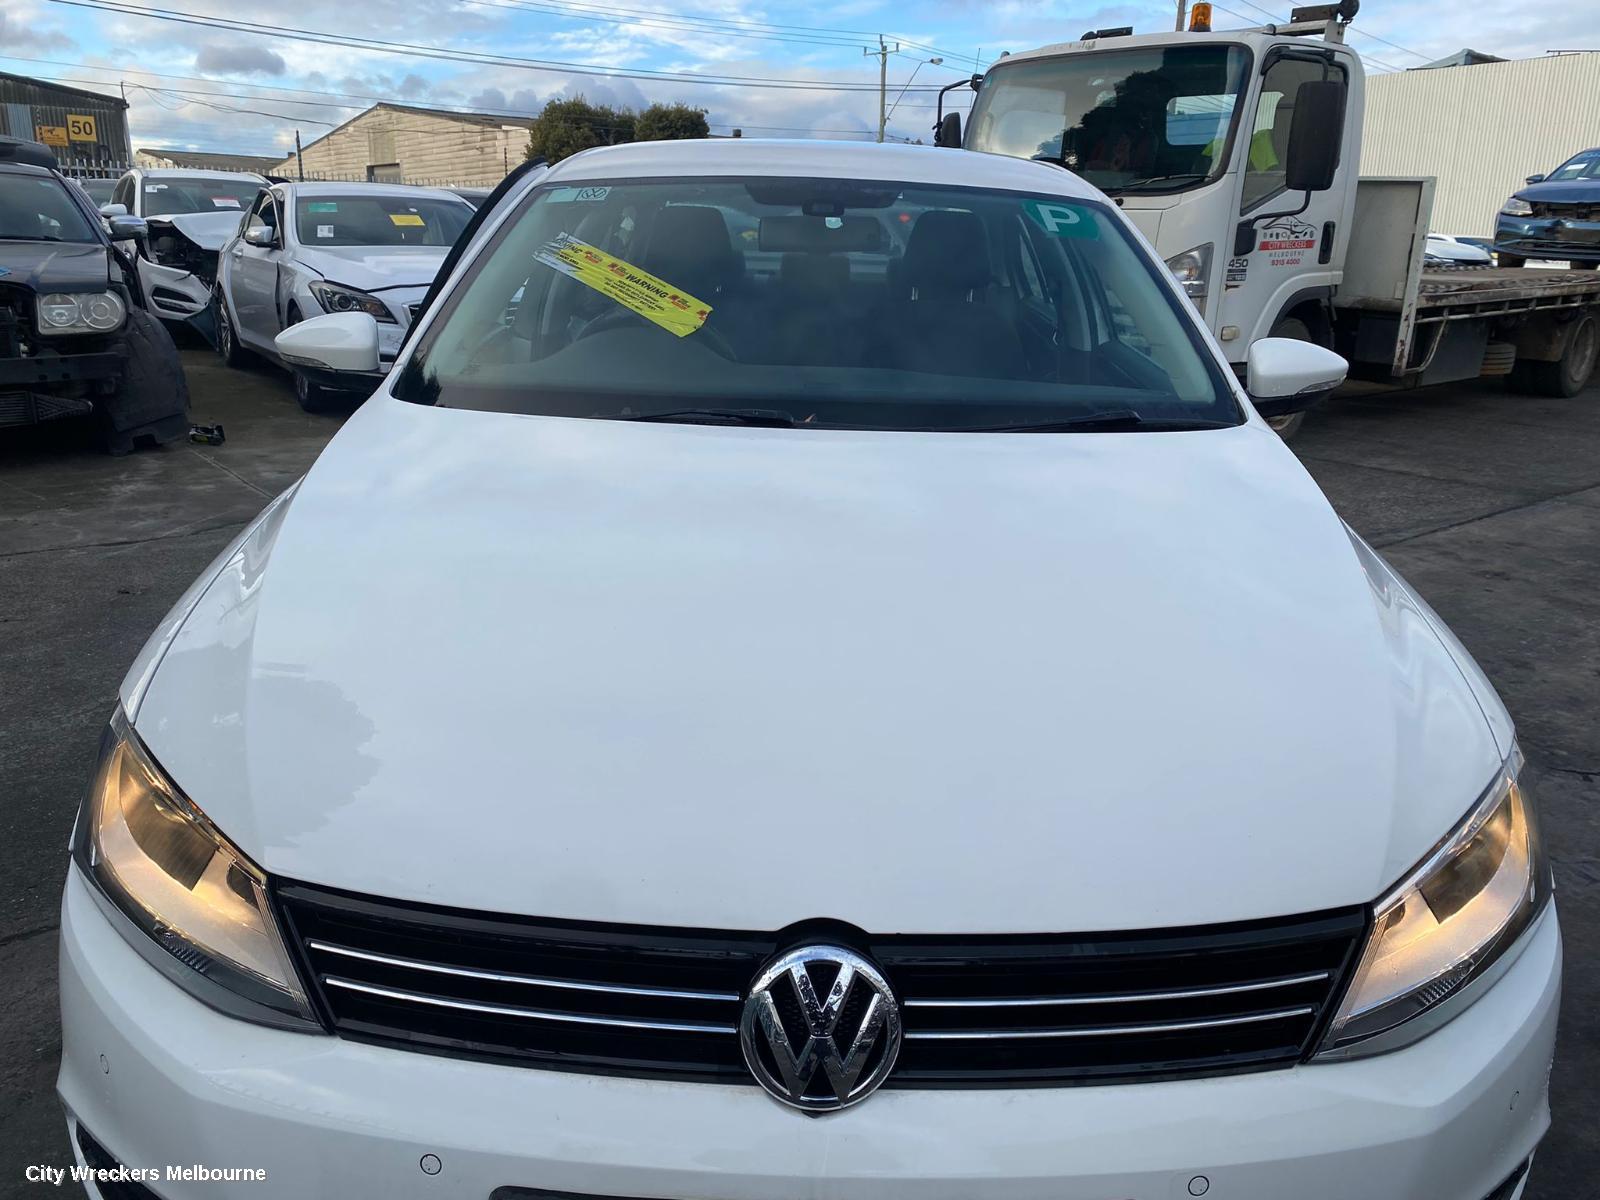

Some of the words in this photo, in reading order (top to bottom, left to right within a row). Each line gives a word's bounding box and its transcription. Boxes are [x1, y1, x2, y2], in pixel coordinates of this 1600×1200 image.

[71, 120, 93, 136] 50
[1035, 203, 1081, 233] P
[1228, 258, 1249, 268] 450
[625, 273, 669, 299] WARNING
